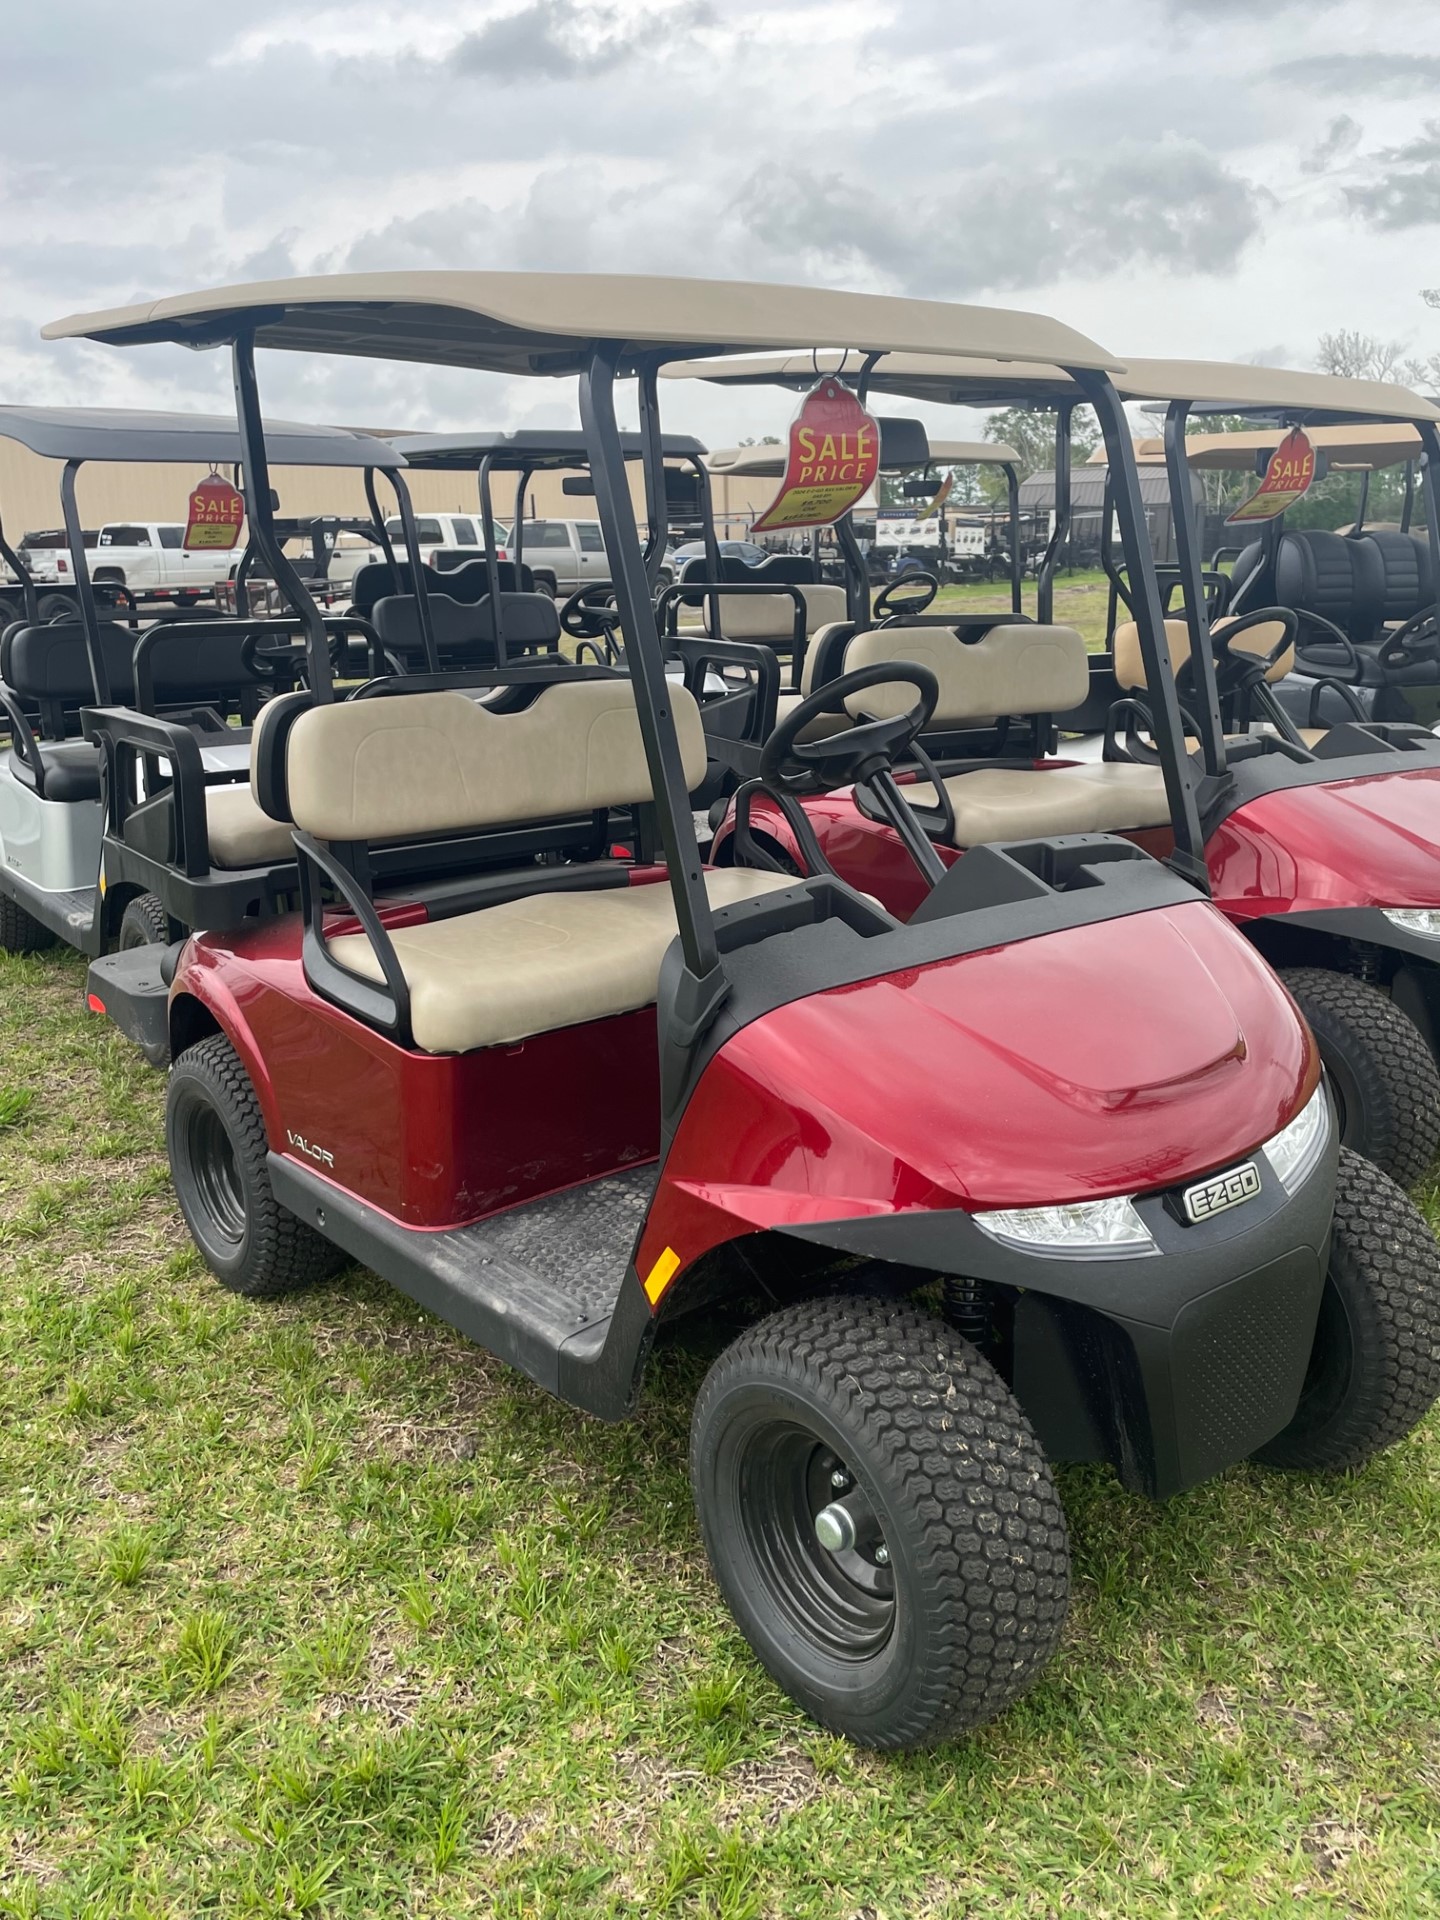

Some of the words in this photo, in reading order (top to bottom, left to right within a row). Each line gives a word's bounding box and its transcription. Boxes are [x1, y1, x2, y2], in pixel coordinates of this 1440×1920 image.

[798, 423, 873, 463] SALE
[799, 462, 867, 484] PRICE
[1271, 453, 1312, 480] SALE
[1267, 478, 1306, 490] PRICE
[194, 495, 239, 514] SALE
[197, 513, 238, 523] PRICE
[286, 1129, 334, 1168] VALOR
[1190, 1168, 1259, 1217] EZGO
